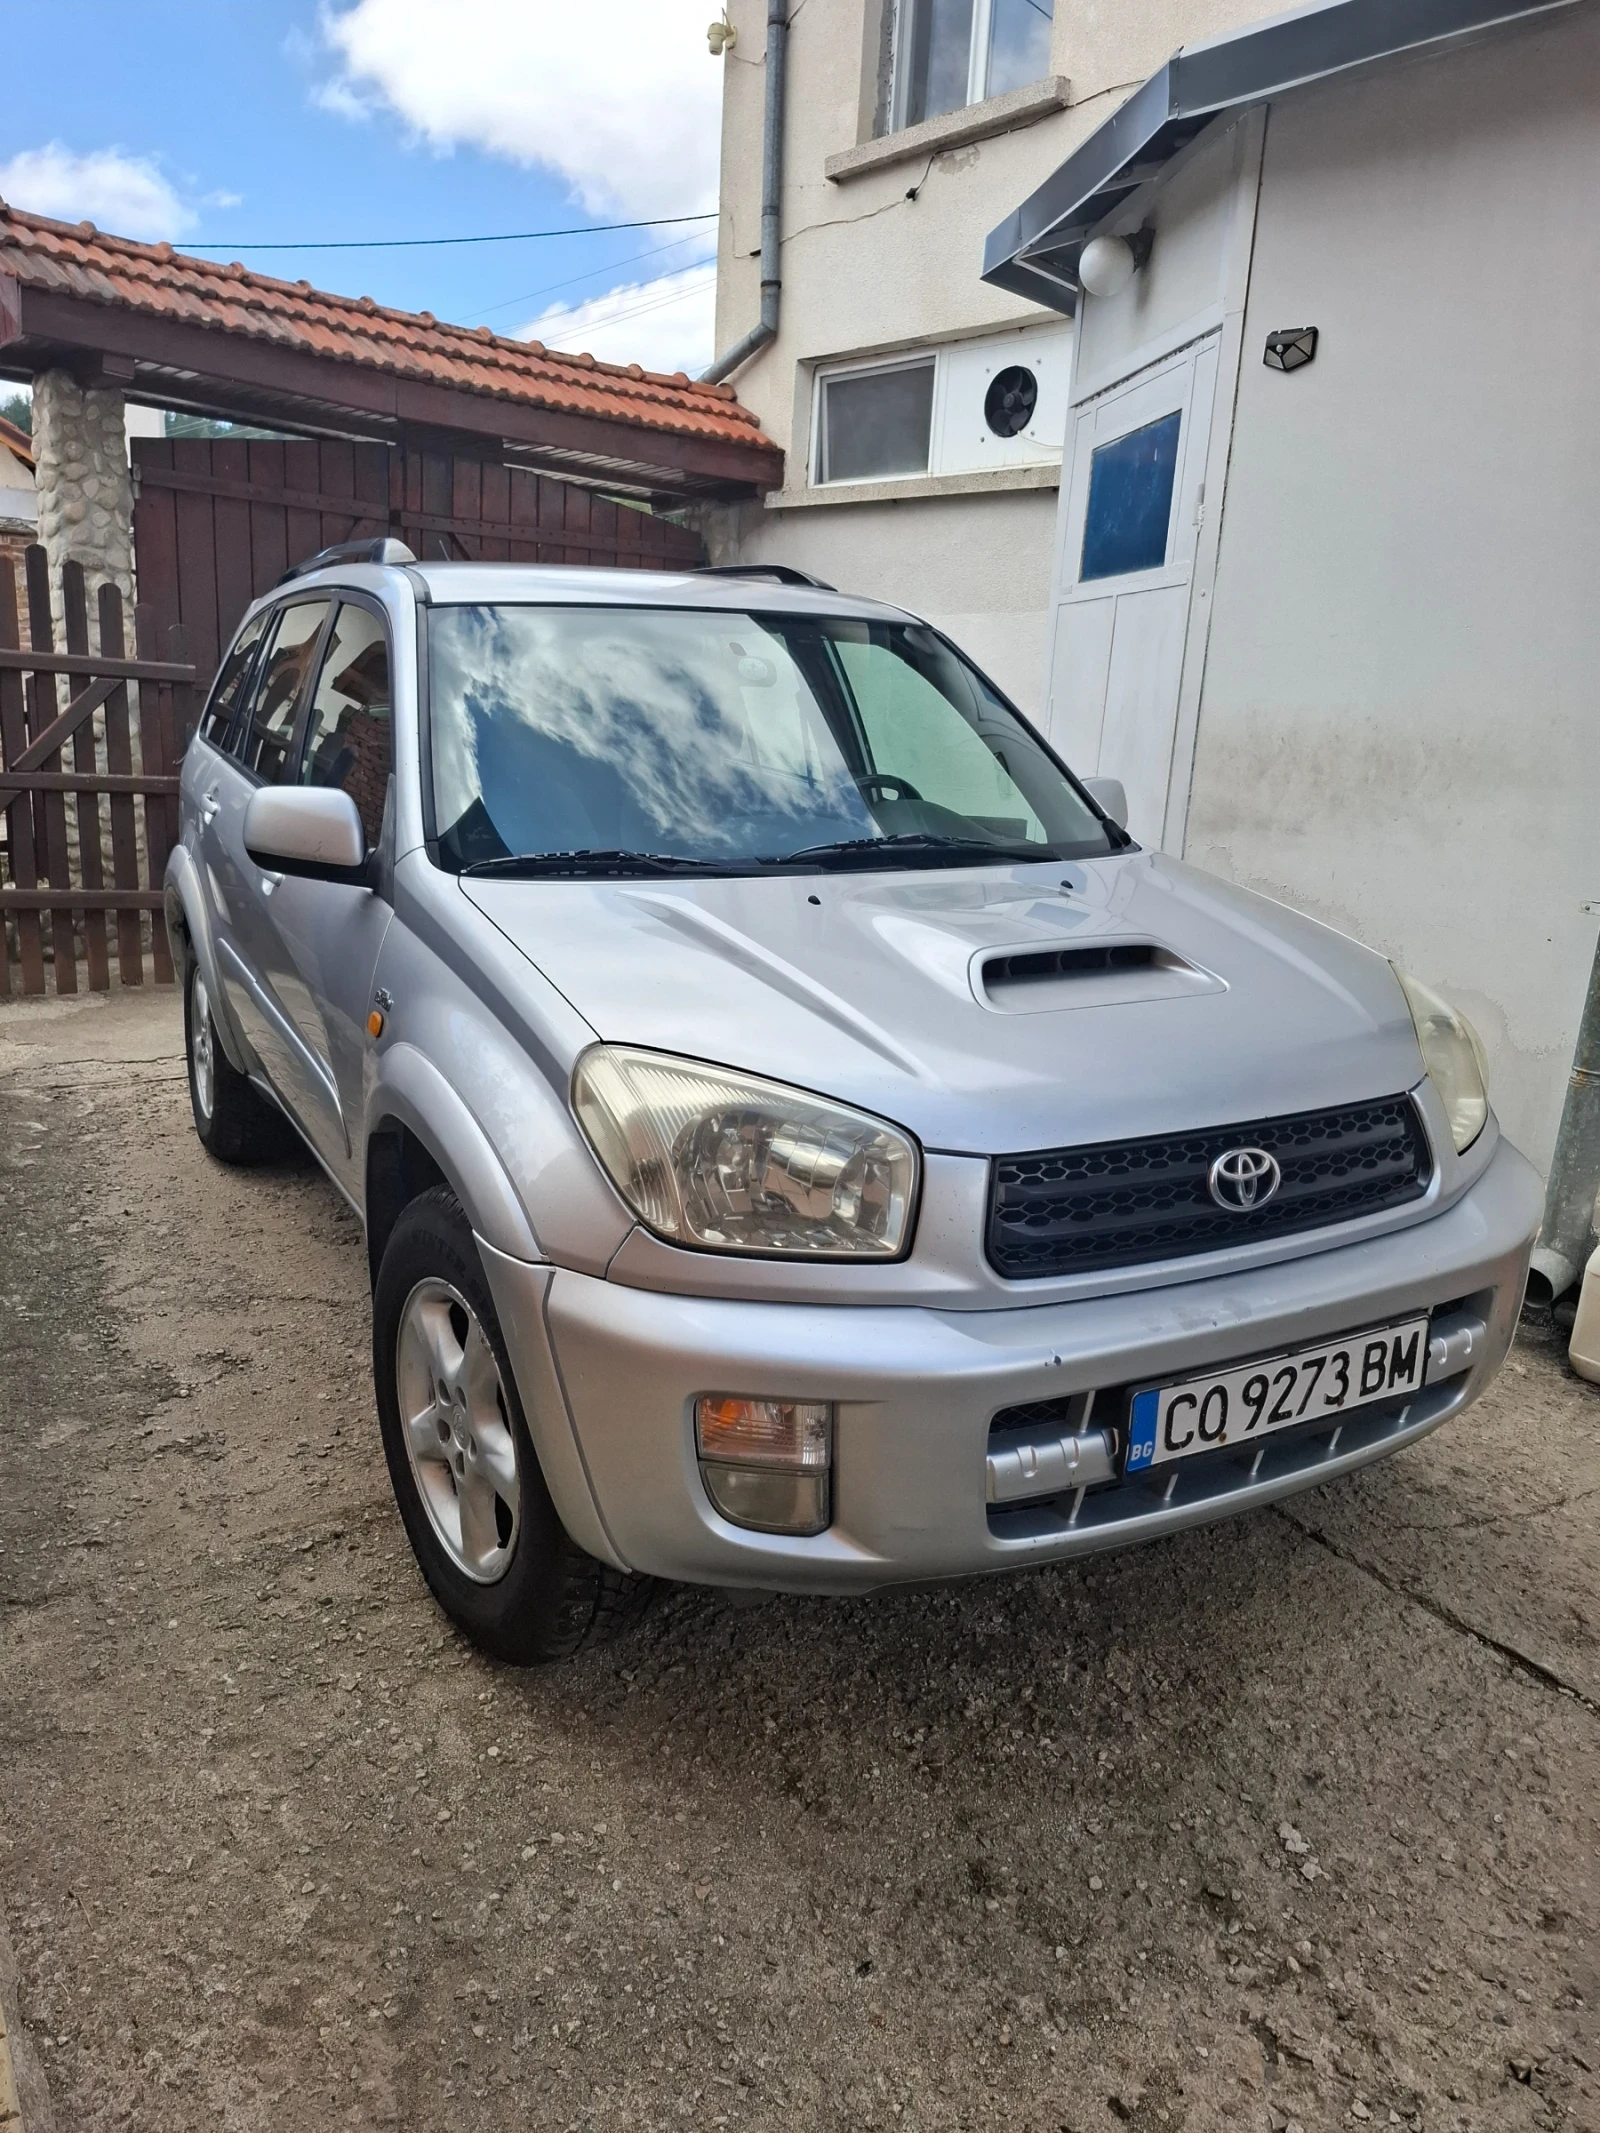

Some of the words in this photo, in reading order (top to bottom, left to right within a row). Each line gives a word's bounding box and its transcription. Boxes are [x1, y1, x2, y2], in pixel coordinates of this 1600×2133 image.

[1164, 1392, 1229, 1452] CO
[1242, 1350, 1350, 1431] 9273
[1359, 1330, 1420, 1398] BM
[1130, 1441, 1153, 1461] BG
